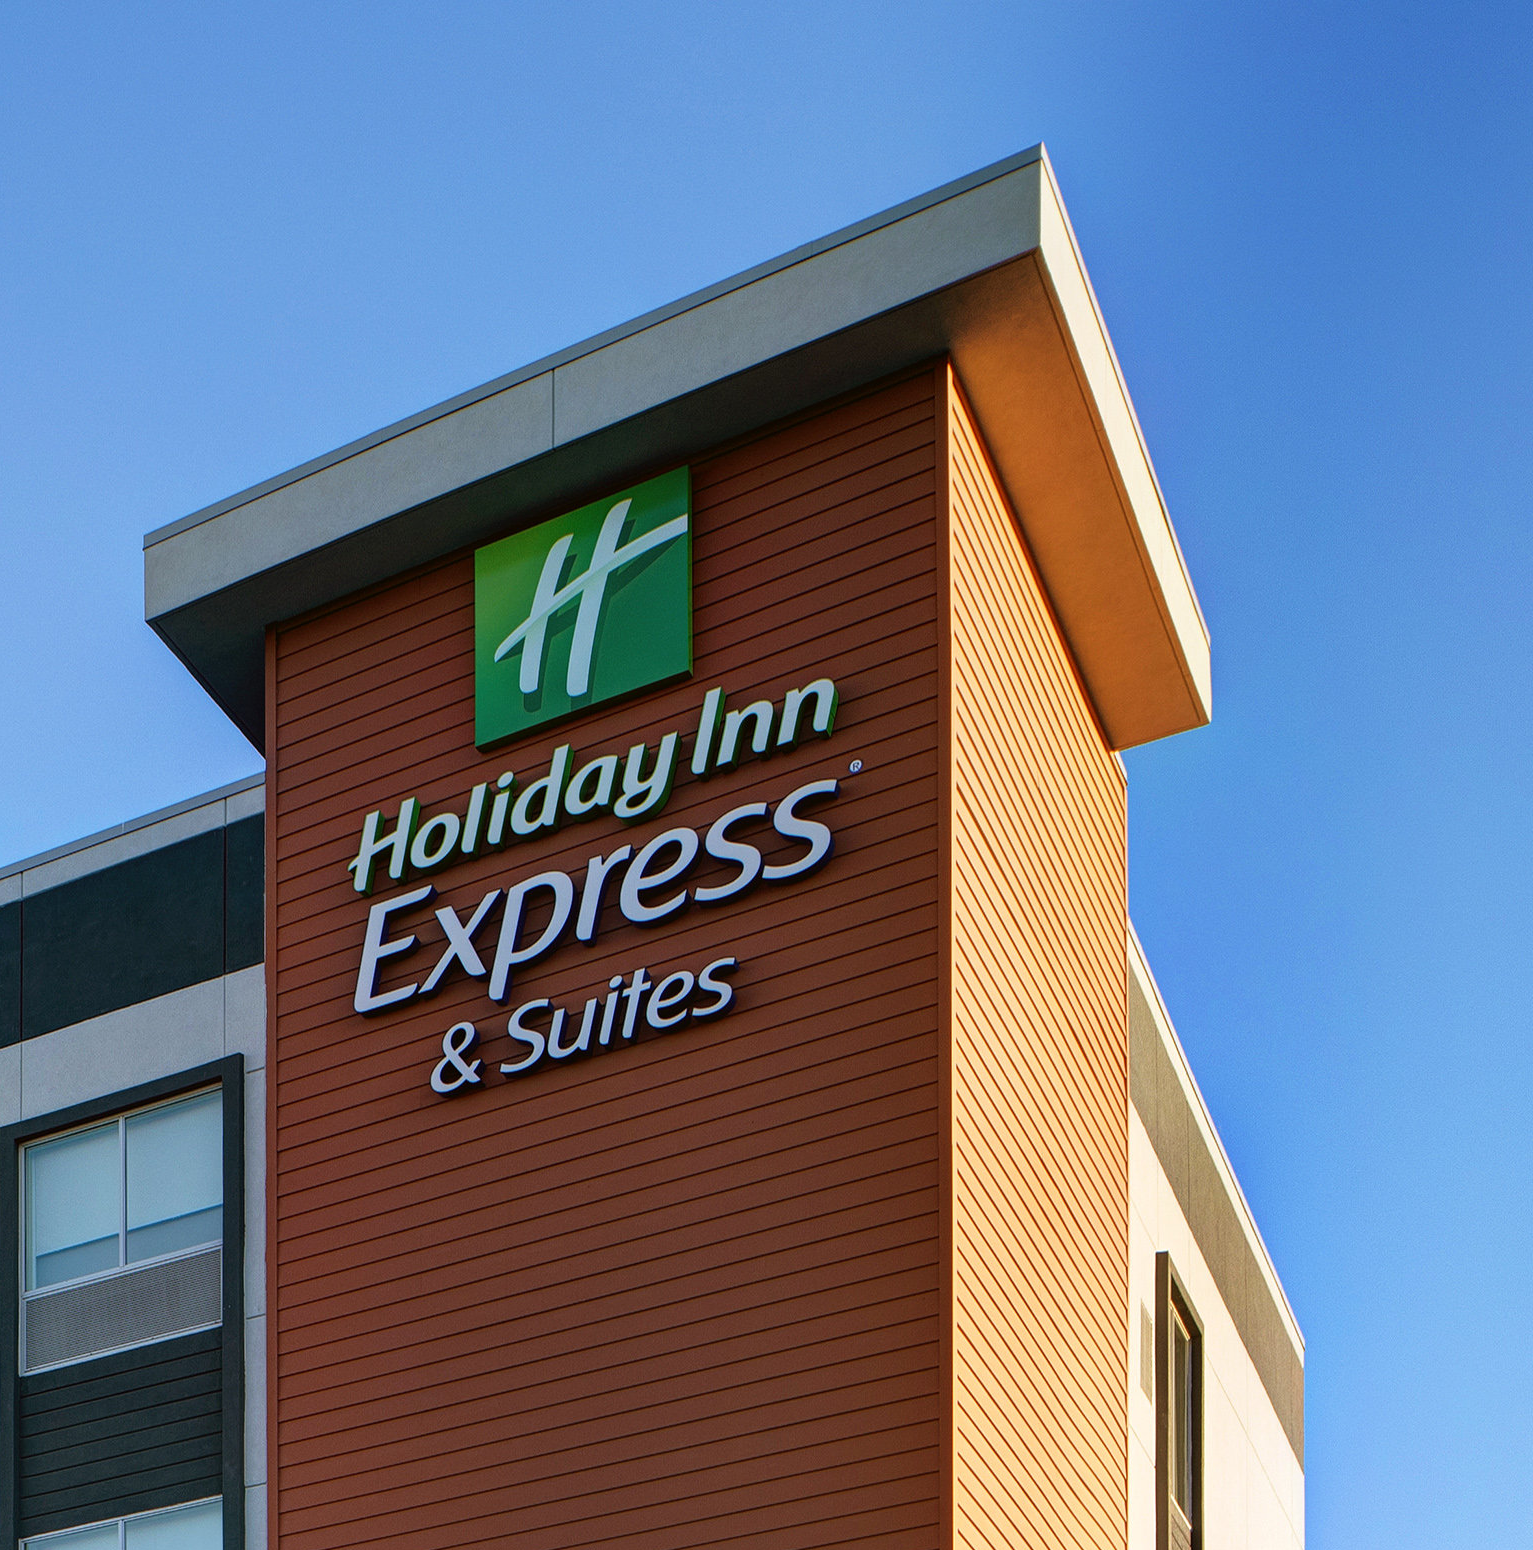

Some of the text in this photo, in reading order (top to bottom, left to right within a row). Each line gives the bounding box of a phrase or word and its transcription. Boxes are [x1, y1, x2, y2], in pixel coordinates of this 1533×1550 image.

[347, 678, 838, 893] Holiday Inn
[353, 778, 840, 1014] Express
[430, 957, 738, 1094] & Suites
